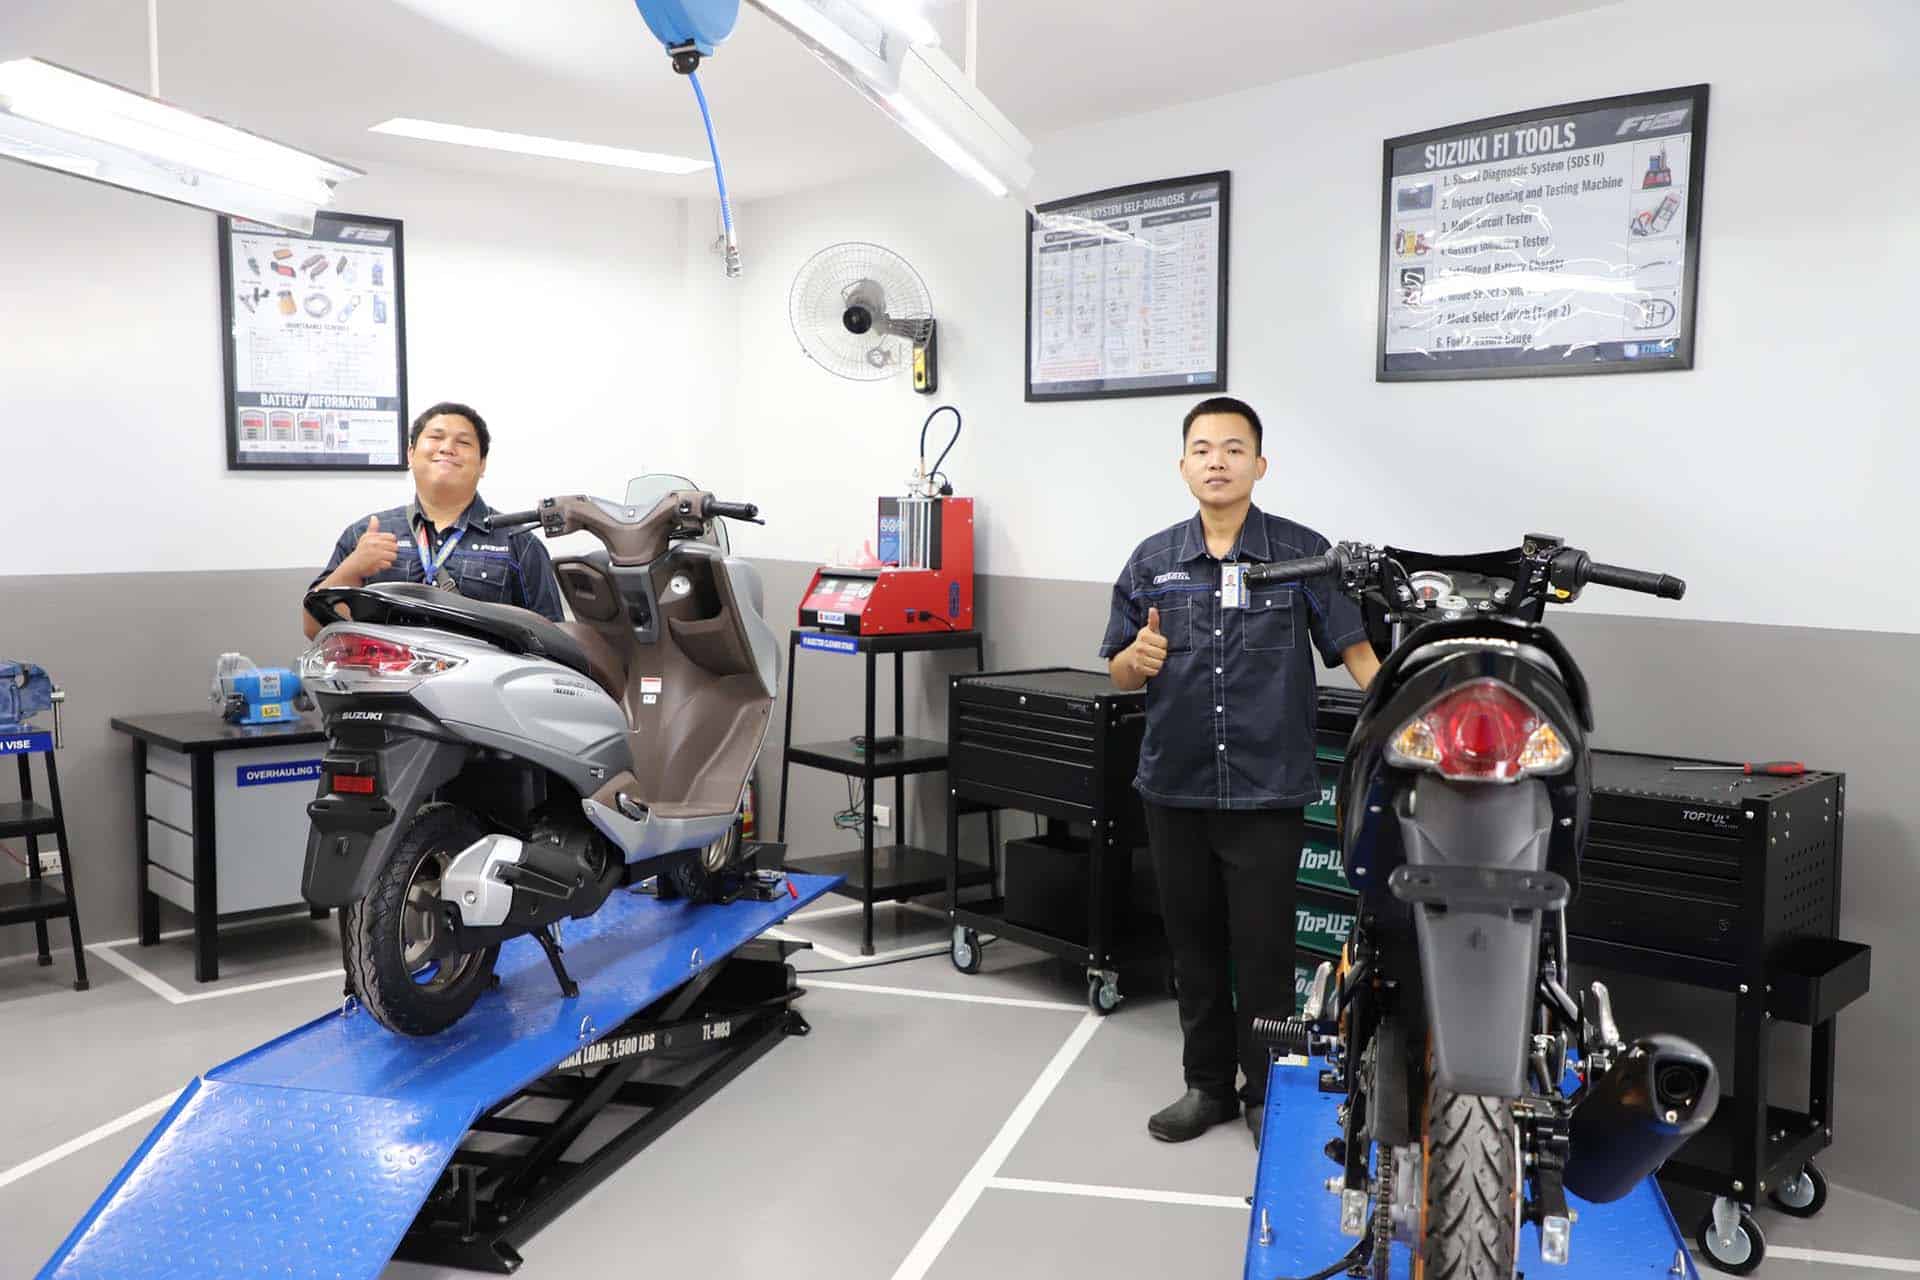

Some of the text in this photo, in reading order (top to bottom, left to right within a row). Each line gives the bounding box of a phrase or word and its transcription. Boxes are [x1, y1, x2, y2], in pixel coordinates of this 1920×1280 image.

[1425, 122, 1576, 169] SUZUKI FI TOOLS
[1482, 165, 1528, 182] Diagnostic
[1530, 160, 1564, 176] System
[1567, 155, 1590, 172] (SDS
[1593, 152, 1605, 168] II)
[1486, 189, 1523, 204] Cleaning
[1525, 186, 1542, 199] and
[1545, 182, 1579, 196] Testing
[1582, 176, 1623, 192] Machine
[1094, 204, 1122, 218] SYSTEM
[1124, 193, 1185, 214] SELF-DIAGNOSIS
[1506, 213, 1533, 225] Tester
[1522, 236, 1549, 248] Tester
[1472, 311, 1499, 322] Select
[260, 392, 305, 408] BATTERY
[342, 711, 383, 721] SUZUKI
[6, 739, 31, 750] VISE
[246, 766, 313, 780] OVERHAULING
[1682, 810, 1726, 825] TOPTUL
[584, 1042, 611, 1065] LOAD:
[613, 1036, 637, 1060] 1,500
[639, 1033, 656, 1053] LBS
